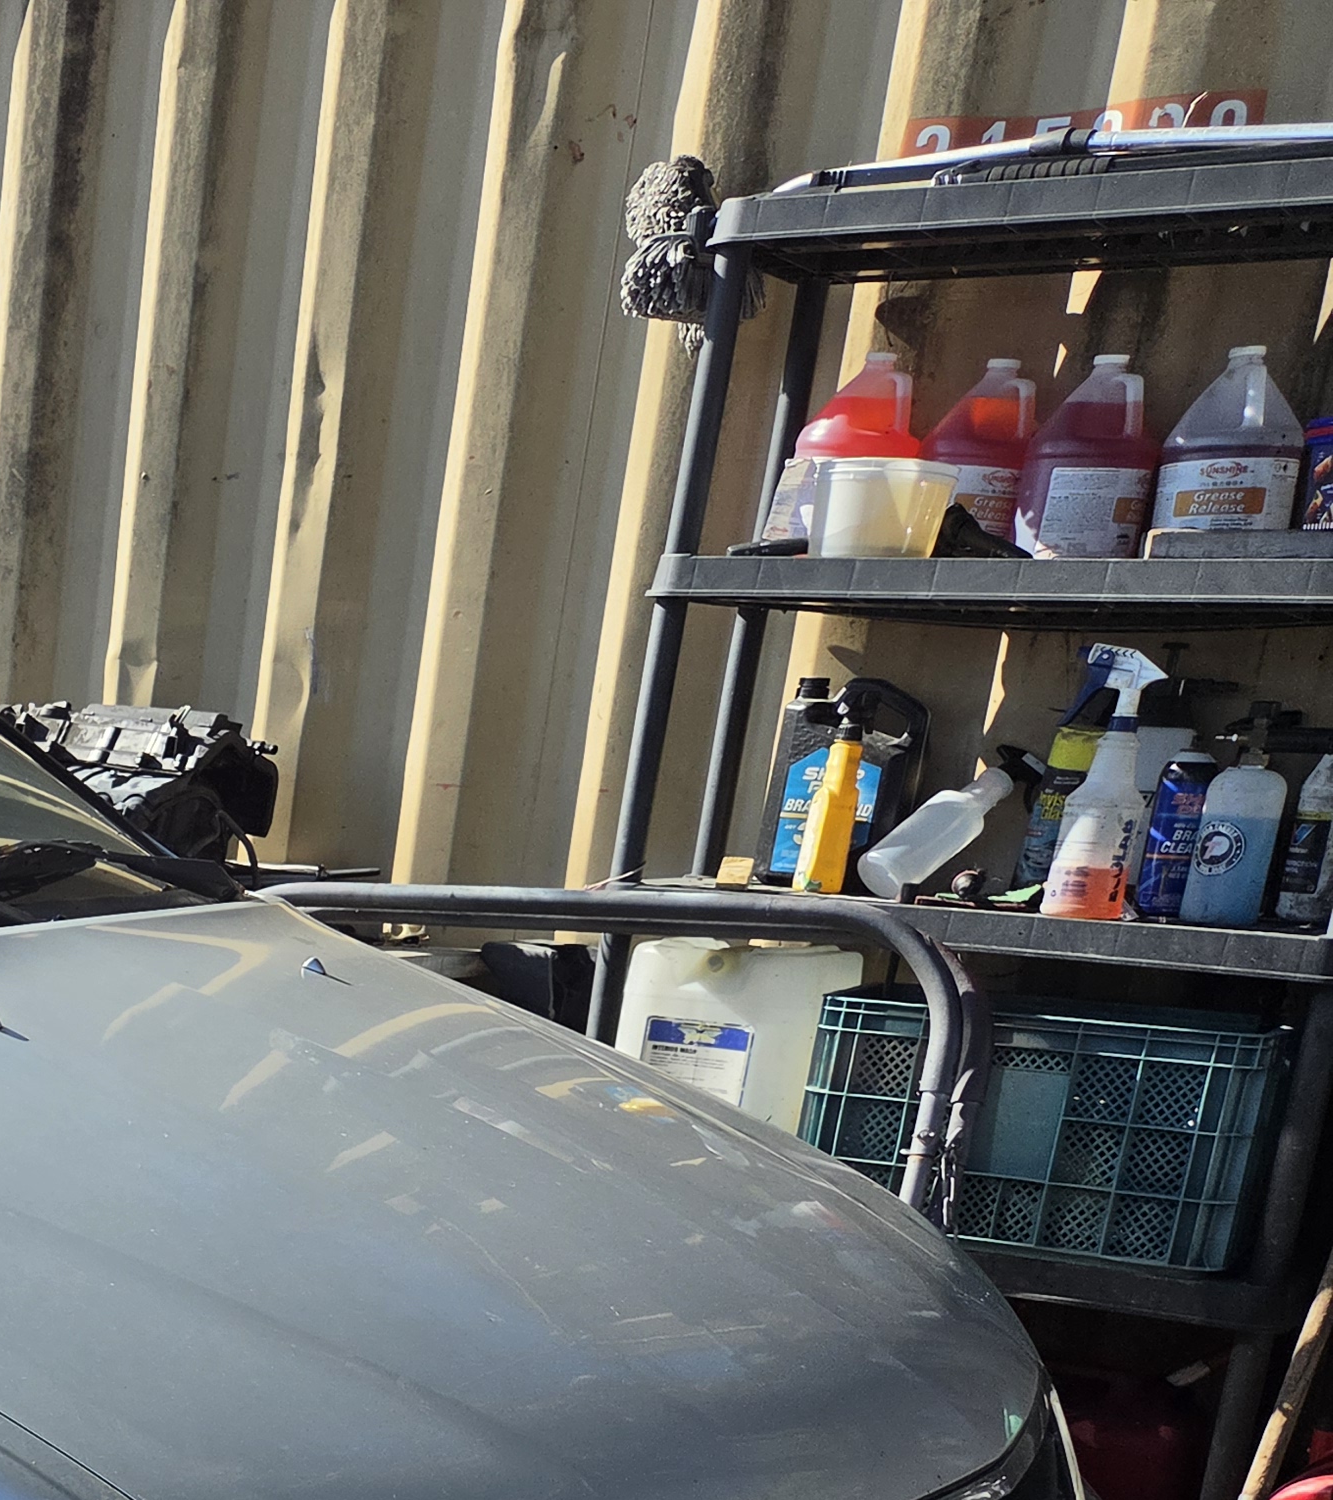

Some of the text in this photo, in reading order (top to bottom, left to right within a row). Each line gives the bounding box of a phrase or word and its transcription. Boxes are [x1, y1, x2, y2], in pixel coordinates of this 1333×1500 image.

[1199, 463, 1249, 477] SUNSHINE
[1193, 490, 1245, 502] Grease
[1188, 501, 1245, 514] Release
[802, 766, 866, 781] SHP
[784, 798, 812, 813] BRA
[1173, 829, 1200, 841] BRA
[1160, 841, 1193, 854] CLEA
